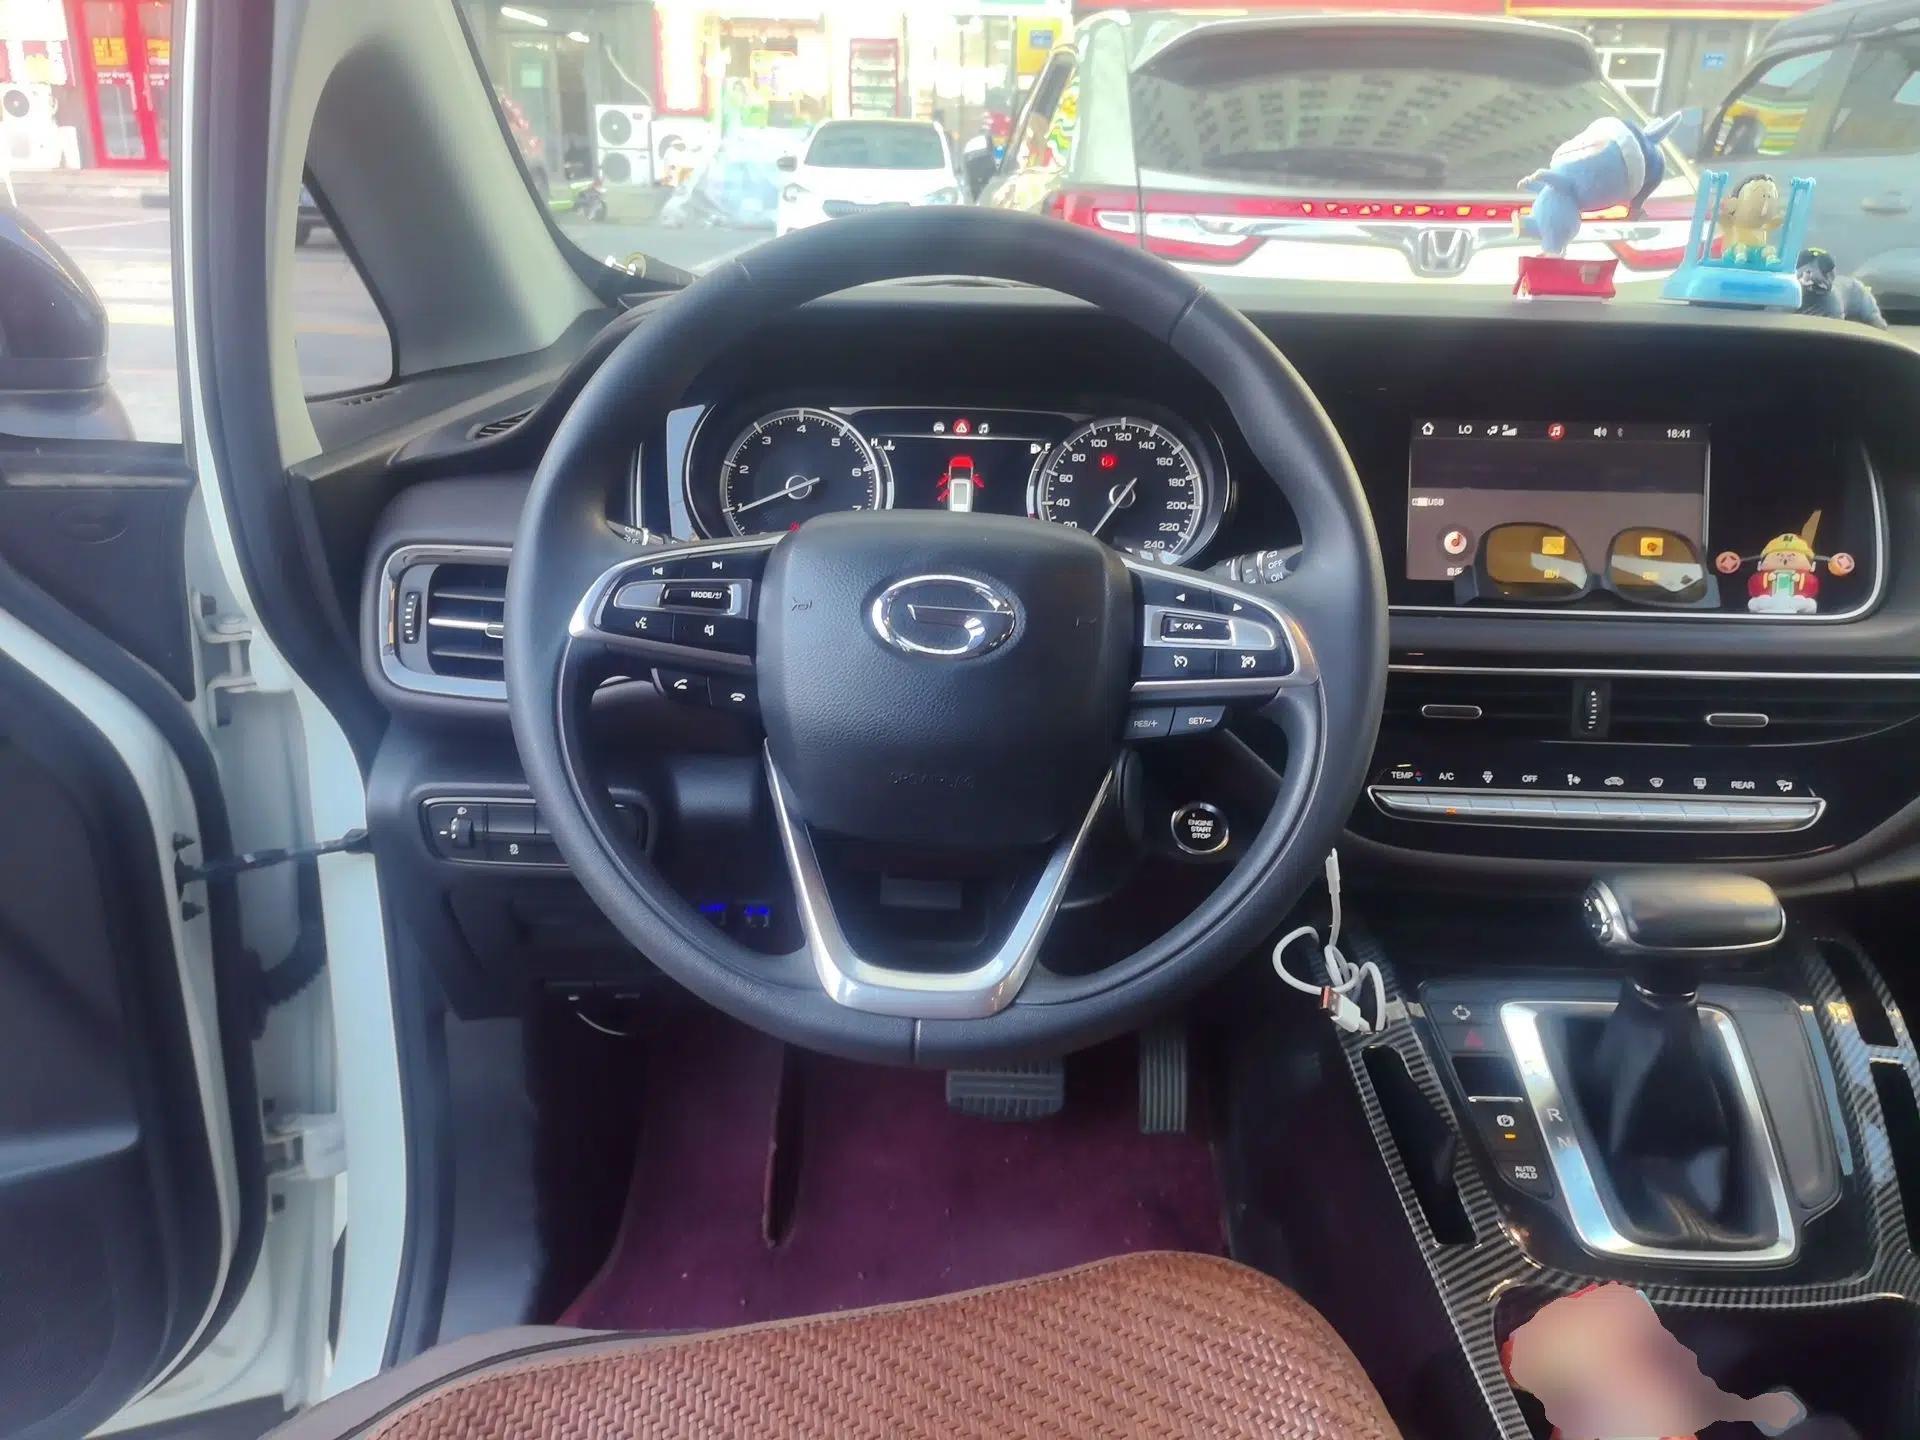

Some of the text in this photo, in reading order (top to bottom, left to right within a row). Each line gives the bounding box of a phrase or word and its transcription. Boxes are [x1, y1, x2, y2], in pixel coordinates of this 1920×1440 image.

[797, 425, 806, 433] 4
[1458, 425, 1473, 435] LO
[1666, 428, 1691, 439] 18:41
[762, 437, 772, 445] 3
[1115, 433, 1132, 441] 120
[831, 438, 841, 447] 5
[1090, 439, 1107, 448] 100
[1138, 442, 1155, 450] 140
[1072, 454, 1086, 463] 80
[1156, 458, 1173, 466] 160
[739, 466, 749, 474] 2
[852, 469, 862, 477] 6
[1059, 475, 1073, 483] 60
[1168, 479, 1186, 487] 180
[1056, 499, 1070, 507] 40
[1166, 501, 1187, 510] 200
[1159, 523, 1180, 532] 220
[1144, 540, 1165, 549] 240
[1268, 560, 1283, 569] OFF
[1270, 573, 1284, 582] ON
[1182, 622, 1194, 631] OK
[1391, 771, 1413, 779] TEMP
[1439, 772, 1454, 781] A/C
[1521, 774, 1537, 783] OFF
[1730, 780, 1755, 789] REAR
[1547, 1108, 1563, 1122] R
[1515, 1165, 1536, 1173] AUTO
